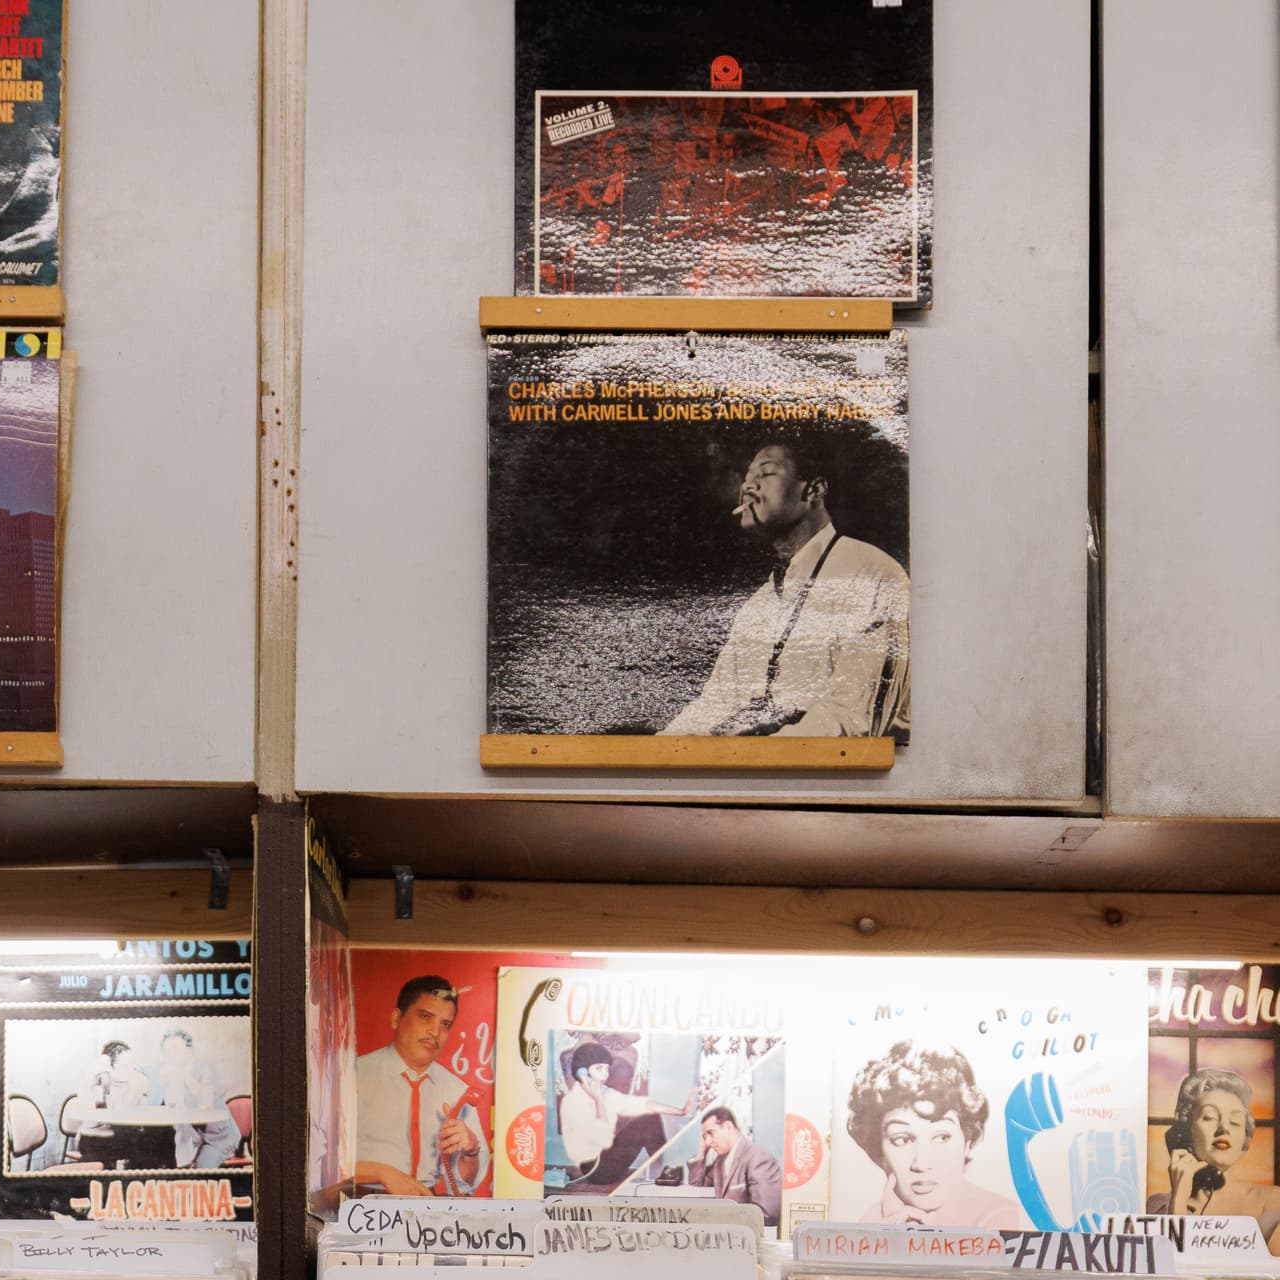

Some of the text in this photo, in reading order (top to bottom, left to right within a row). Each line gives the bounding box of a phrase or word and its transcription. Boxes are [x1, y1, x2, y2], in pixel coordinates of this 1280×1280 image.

[545, 104, 595, 125] VOLUME
[548, 112, 614, 140] RECORDED LIVE
[508, 382, 596, 400] CHARLES
[509, 404, 557, 422] WITH
[561, 404, 650, 422] CARMELL
[652, 404, 713, 422] JONES
[717, 404, 756, 422] AND
[59, 975, 88, 988] JULIO
[100, 972, 251, 999] JARAMILLO
[1193, 1219, 1229, 1231] NEW
[405, 1219, 526, 1251] Upchurch
[20, 1244, 164, 1259] BILLY TAYLOR
[805, 1235, 1003, 1257] MIRIAM MAKEBA
